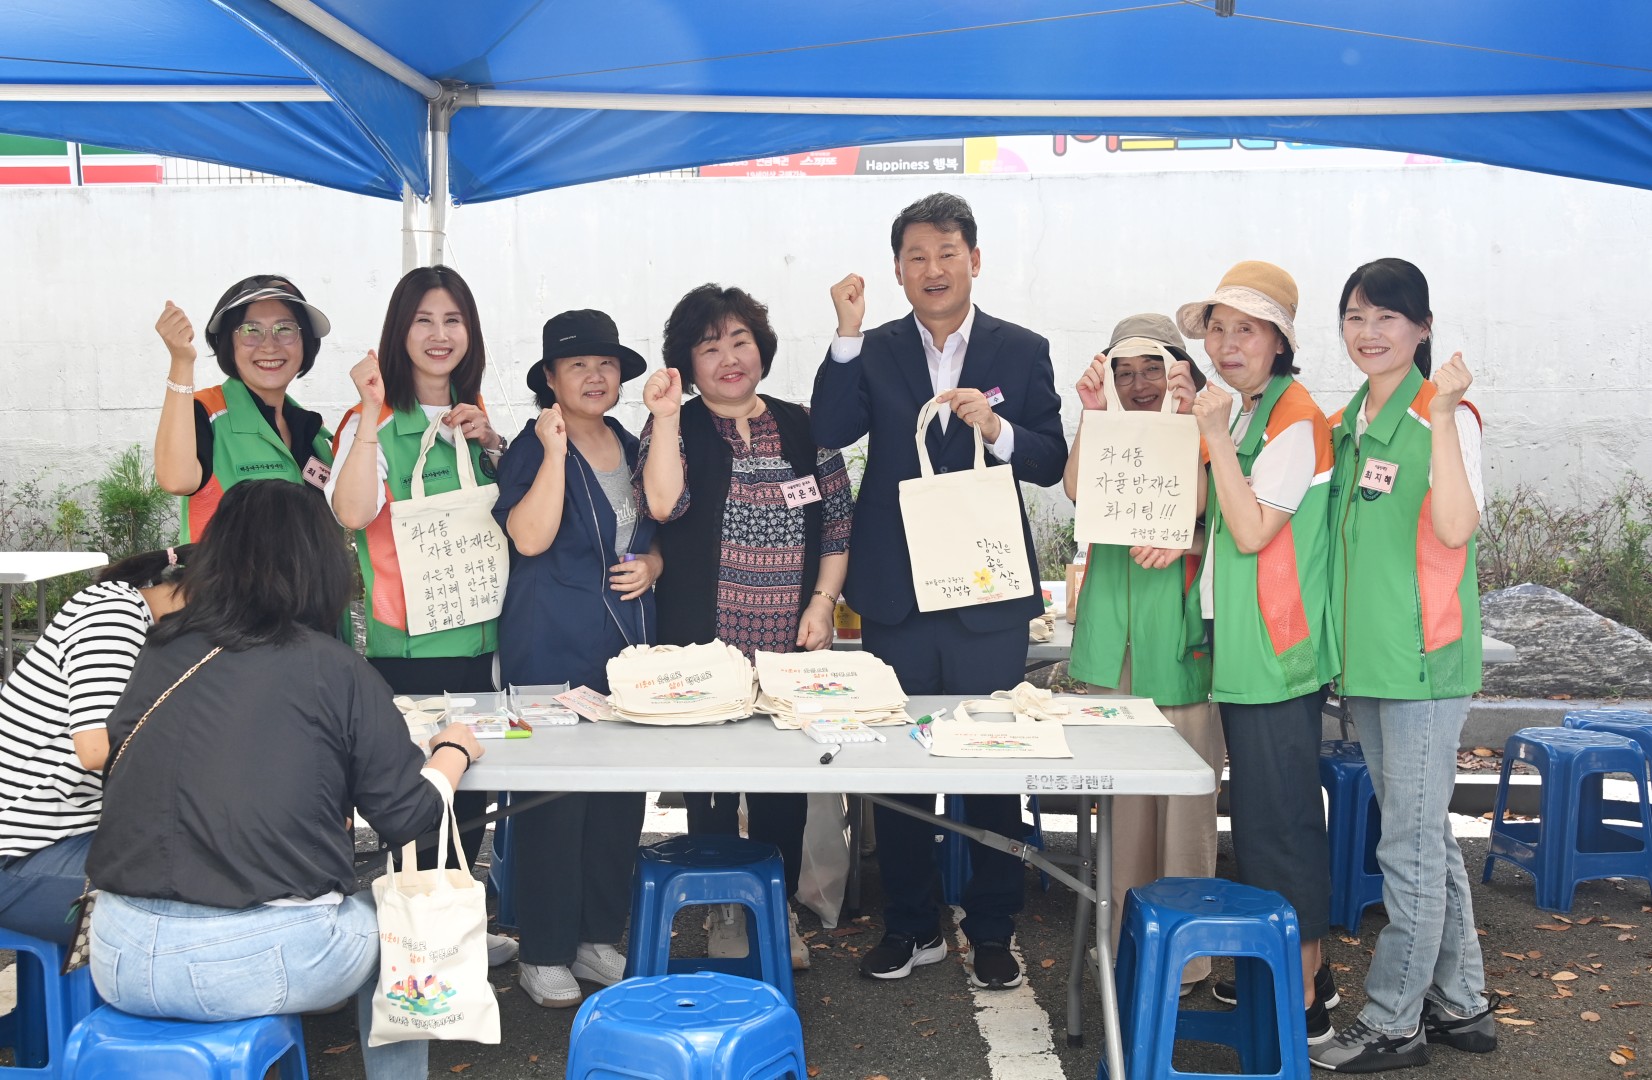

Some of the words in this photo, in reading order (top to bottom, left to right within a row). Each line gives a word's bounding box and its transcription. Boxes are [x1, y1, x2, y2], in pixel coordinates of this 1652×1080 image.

[866, 159, 930, 172] Happiness
[933, 157, 959, 171] 행복
[1095, 472, 1181, 498] 자율방재단
[976, 538, 1011, 555] 당신은
[422, 564, 455, 583] 이은정
[986, 555, 1004, 573] 좋은
[1000, 570, 1020, 590] 사람
[424, 581, 461, 601] 최지혜
